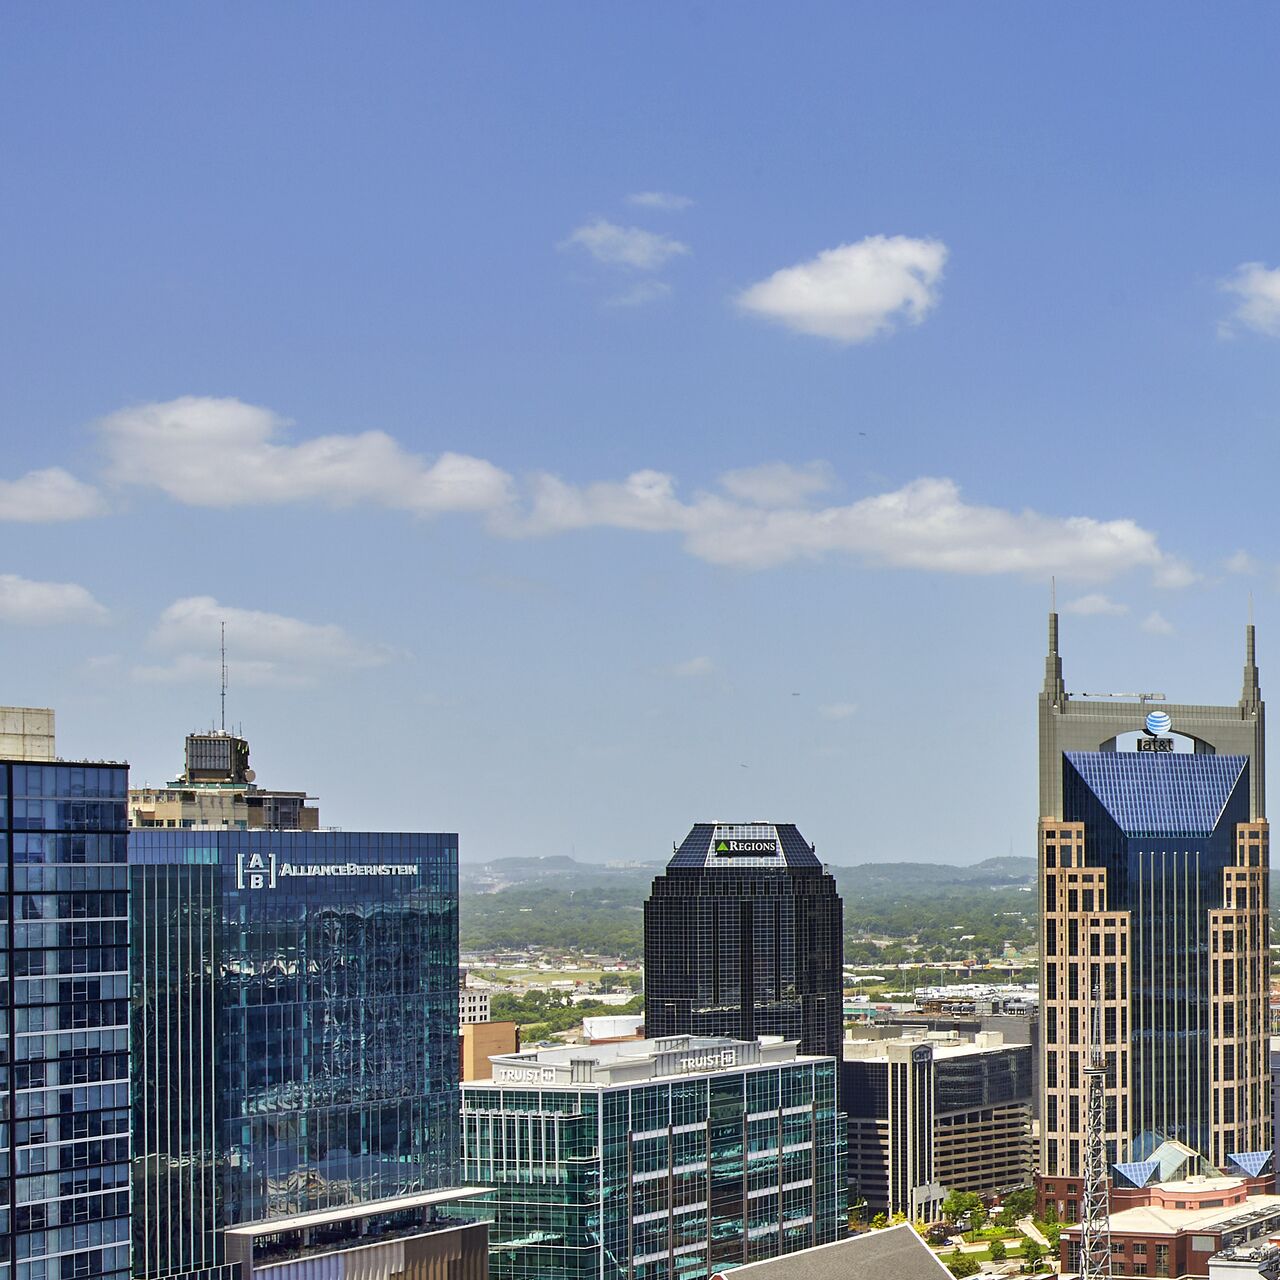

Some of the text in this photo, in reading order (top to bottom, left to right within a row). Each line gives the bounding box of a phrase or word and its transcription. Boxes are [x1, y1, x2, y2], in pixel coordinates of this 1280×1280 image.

[1143, 739, 1174, 751] at&t
[729, 841, 776, 851] REGIONS
[680, 1054, 721, 1070] TRUIST
[500, 1068, 540, 1083] TRUIST
